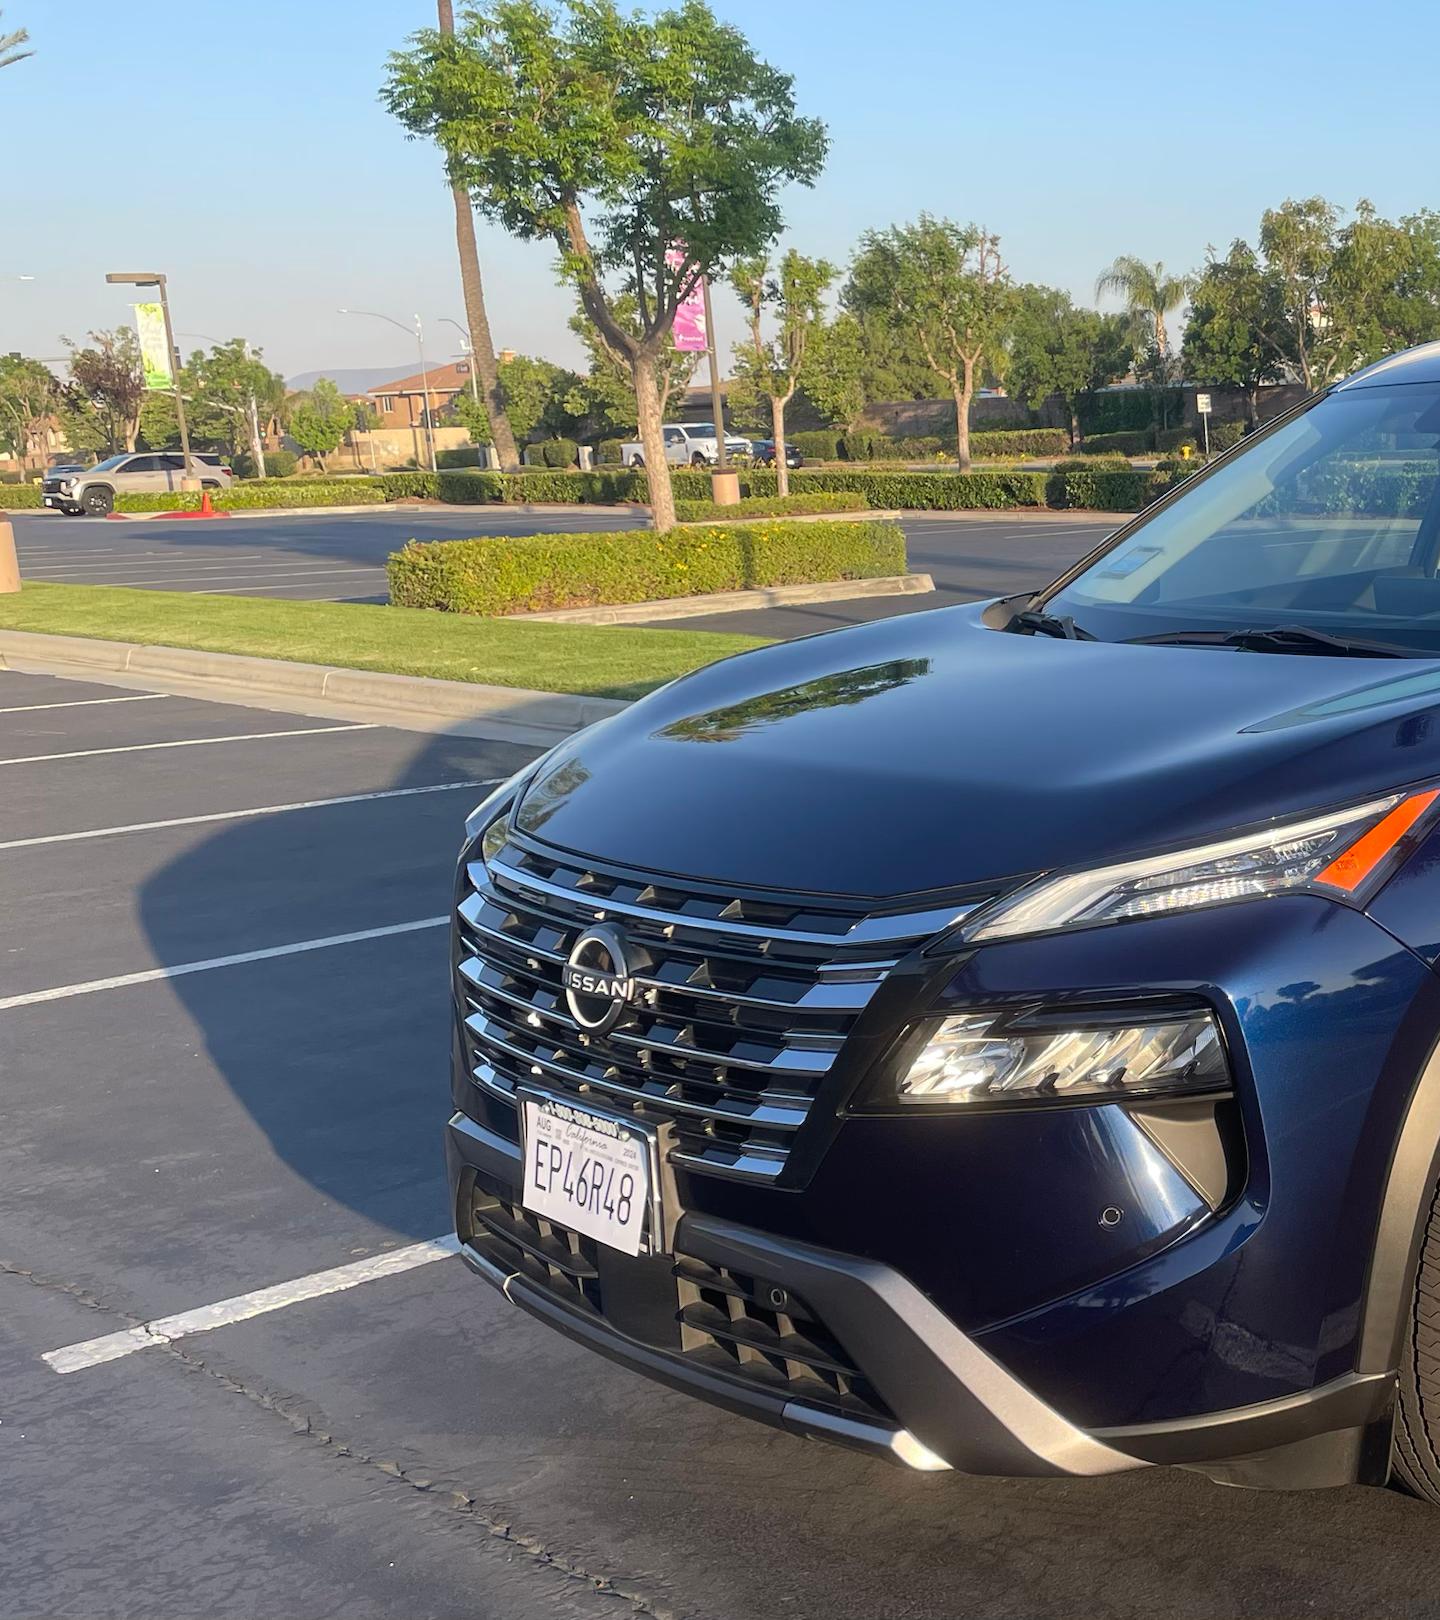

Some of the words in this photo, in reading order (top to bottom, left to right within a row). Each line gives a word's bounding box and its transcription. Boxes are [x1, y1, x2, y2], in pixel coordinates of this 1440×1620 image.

[565, 970, 628, 998] ISSAN
[536, 1116, 552, 1132] AUG
[565, 1123, 608, 1150] California
[534, 1138, 635, 1226] EP46R48
